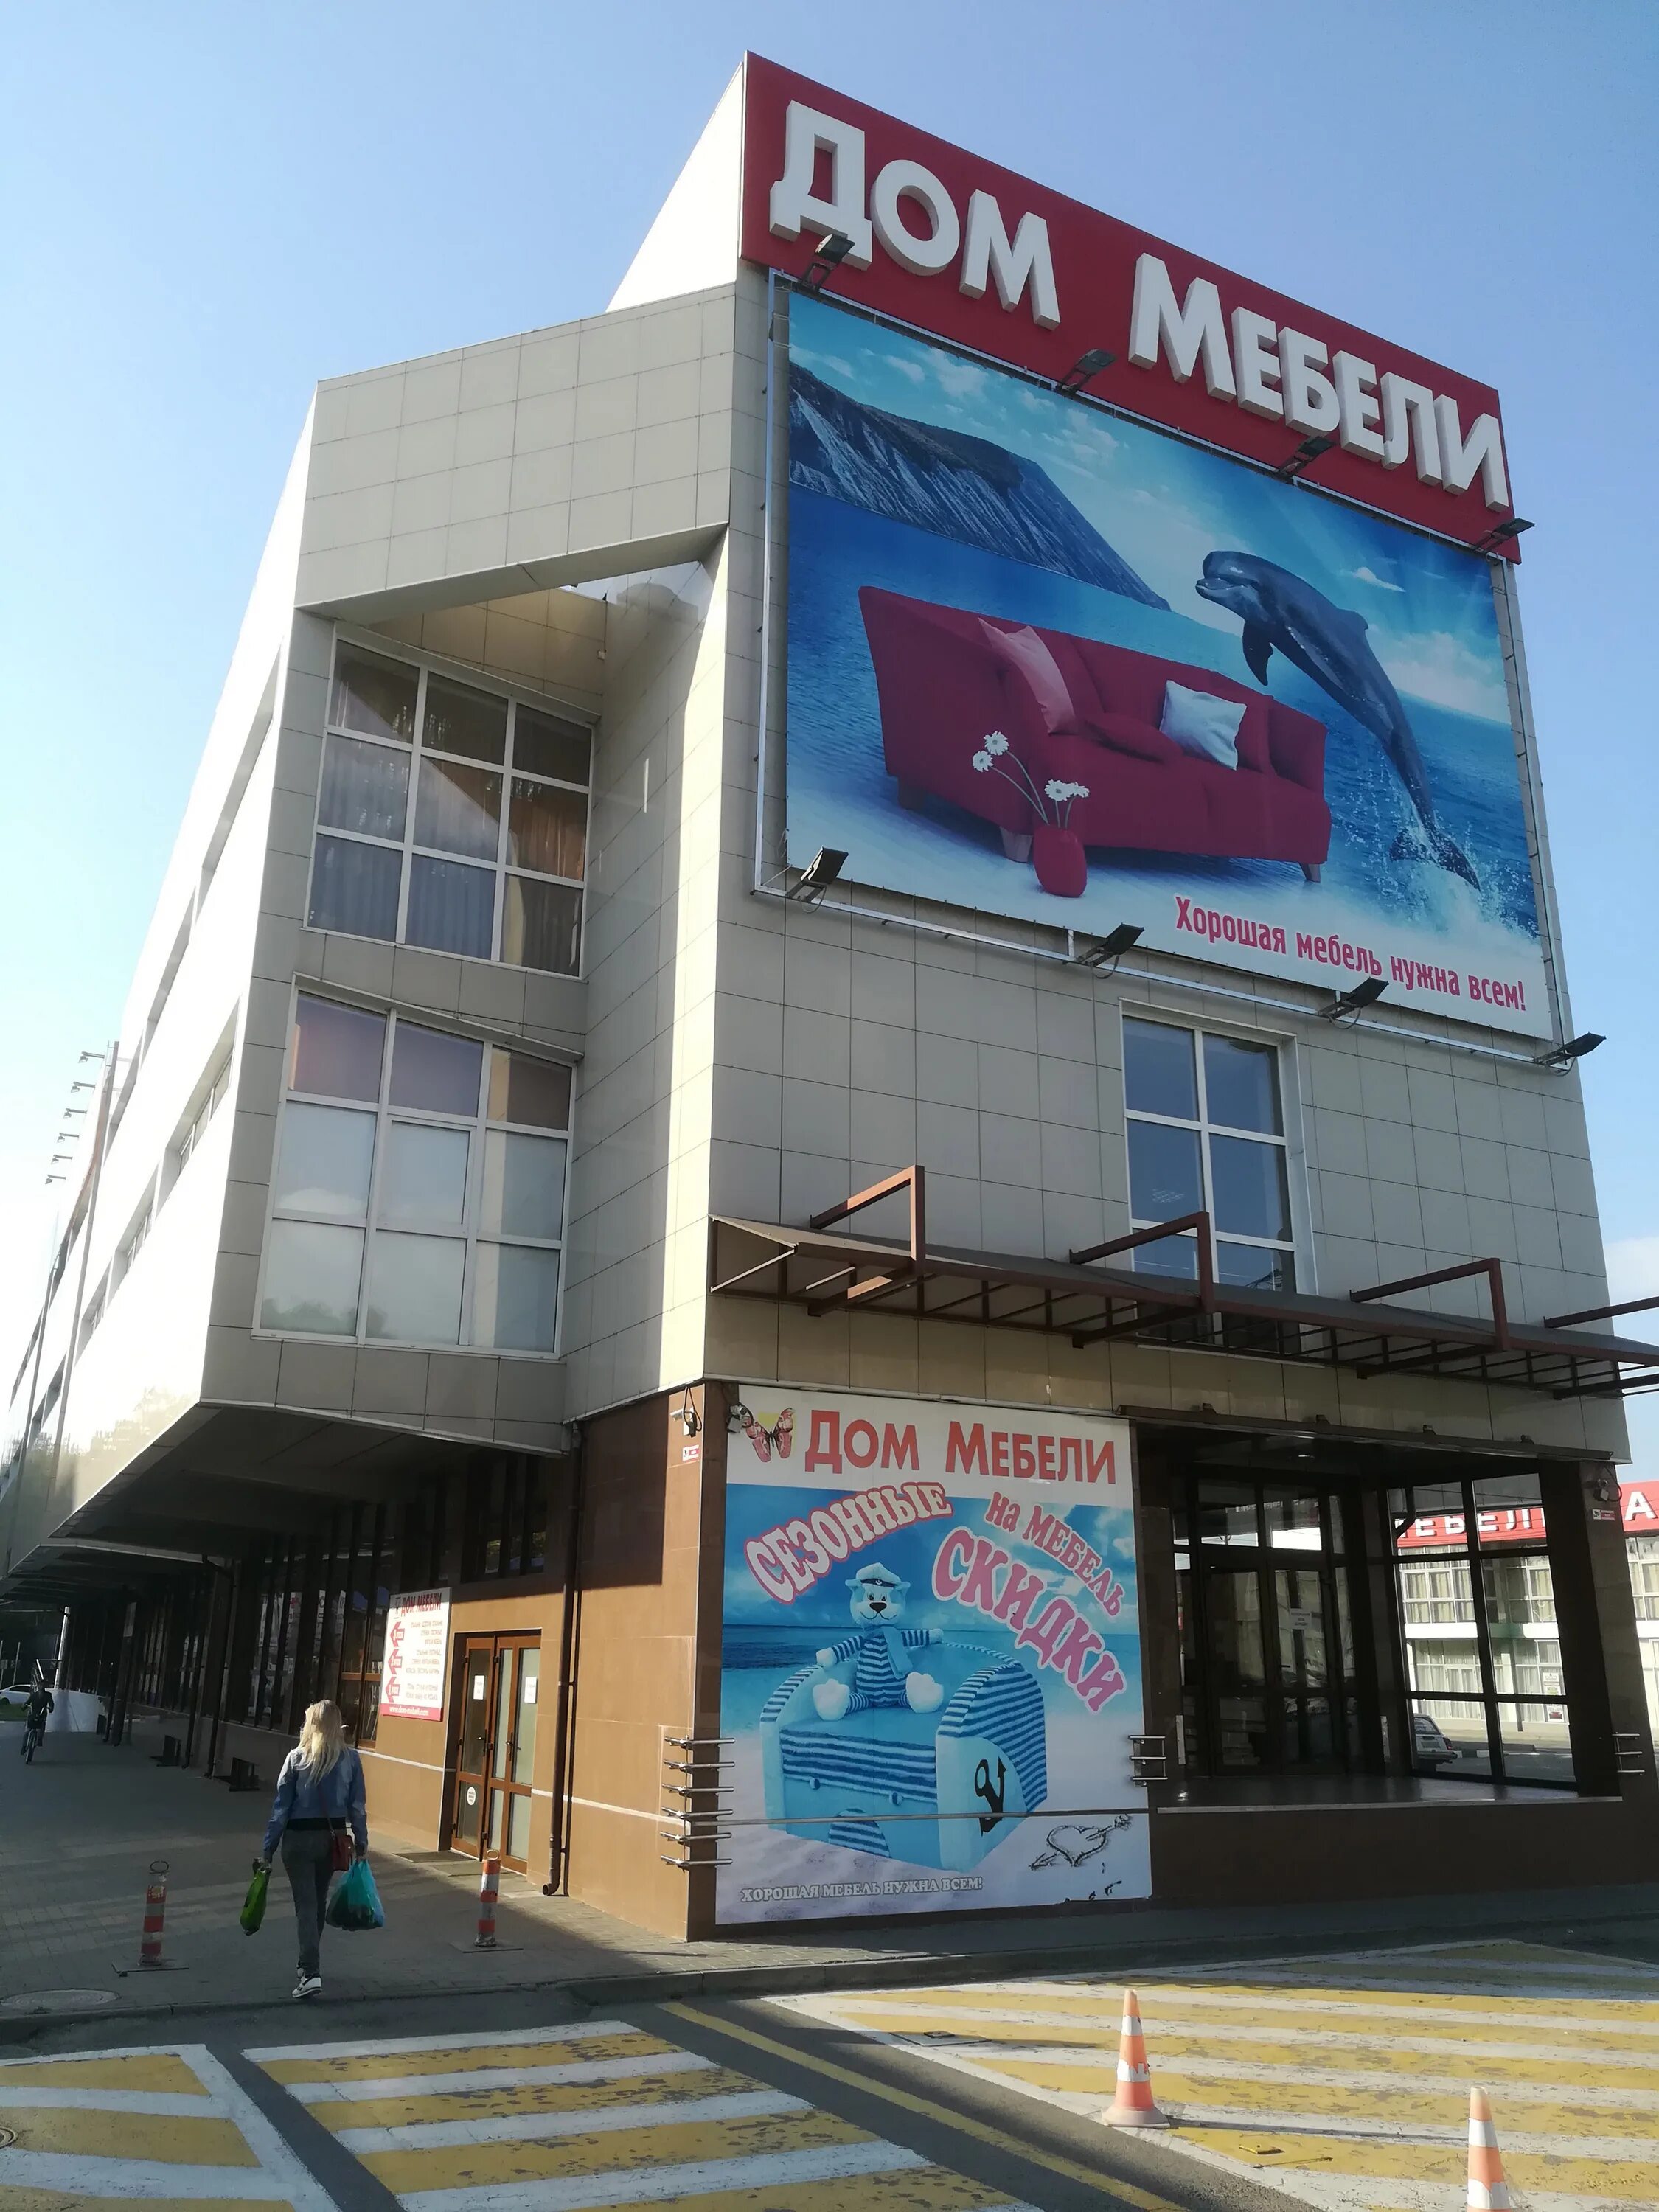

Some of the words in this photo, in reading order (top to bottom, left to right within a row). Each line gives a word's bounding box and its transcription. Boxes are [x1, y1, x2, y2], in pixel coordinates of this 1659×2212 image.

[770, 100, 1061, 330] ДОМ
[1128, 254, 1509, 513] МЕБЕЛИ
[1175, 896, 1287, 955] Хорошая
[1296, 933, 1382, 976] мебель
[1391, 956, 1461, 997] нужна
[1468, 974, 1526, 1012] всем!
[804, 1409, 920, 1475] ДОМ
[946, 1421, 1116, 1485] МЕБЕЛИ
[745, 1482, 953, 1604] СЕЗОННЫЕ
[1022, 1505, 1123, 1617] МЕБЕЛЬ
[933, 1528, 1126, 1713] СКИДКИ
[741, 1884, 821, 1902] ХОРОШАЯ
[821, 1881, 881, 1898] МЕБЕЛЬ
[883, 1879, 939, 1895] НУЖНА
[940, 1877, 984, 1892] ВСЕМ!
